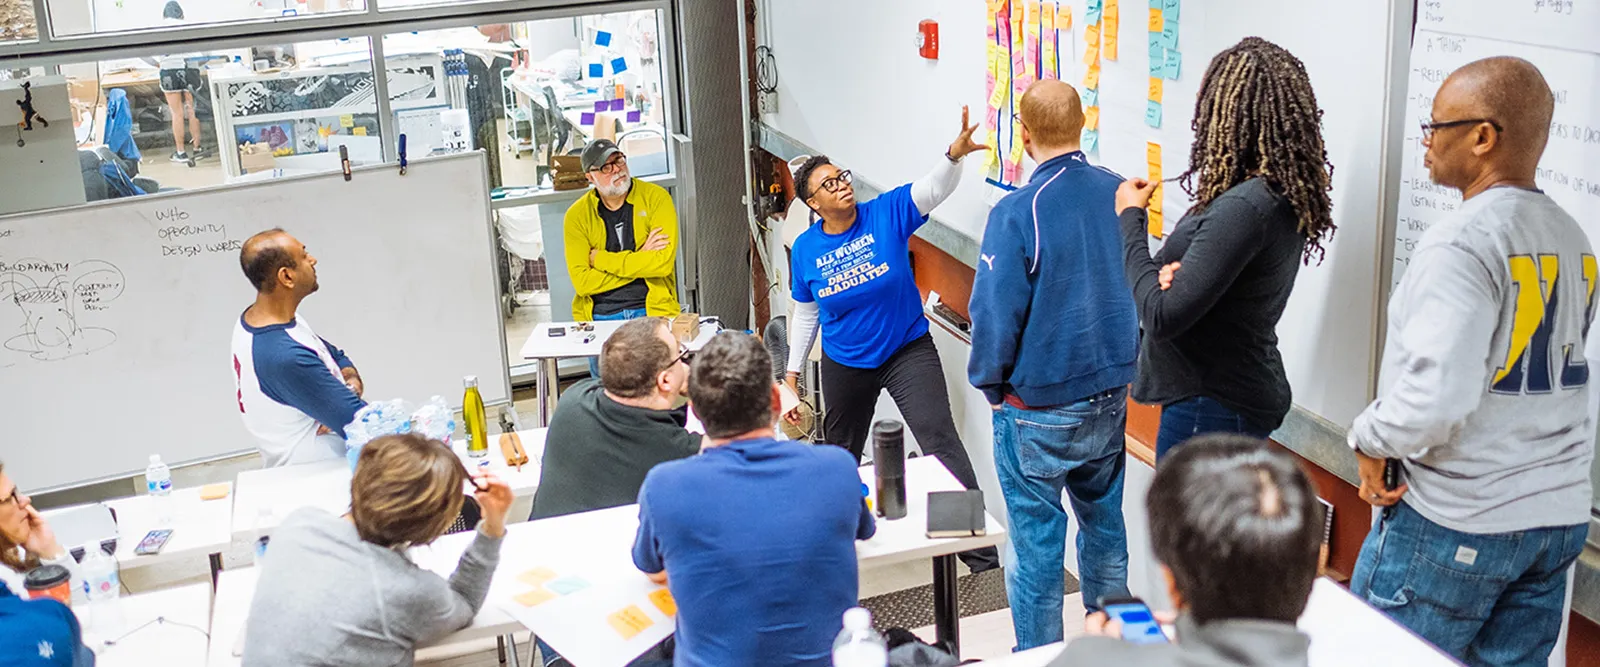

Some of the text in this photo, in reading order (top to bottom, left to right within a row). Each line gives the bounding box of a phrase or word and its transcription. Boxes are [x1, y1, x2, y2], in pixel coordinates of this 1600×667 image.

[156, 206, 190, 221] WHO
[816, 233, 875, 269] ALL WOMEN
[817, 261, 890, 298] GRADUATES
[827, 261, 875, 287] DREXEL
